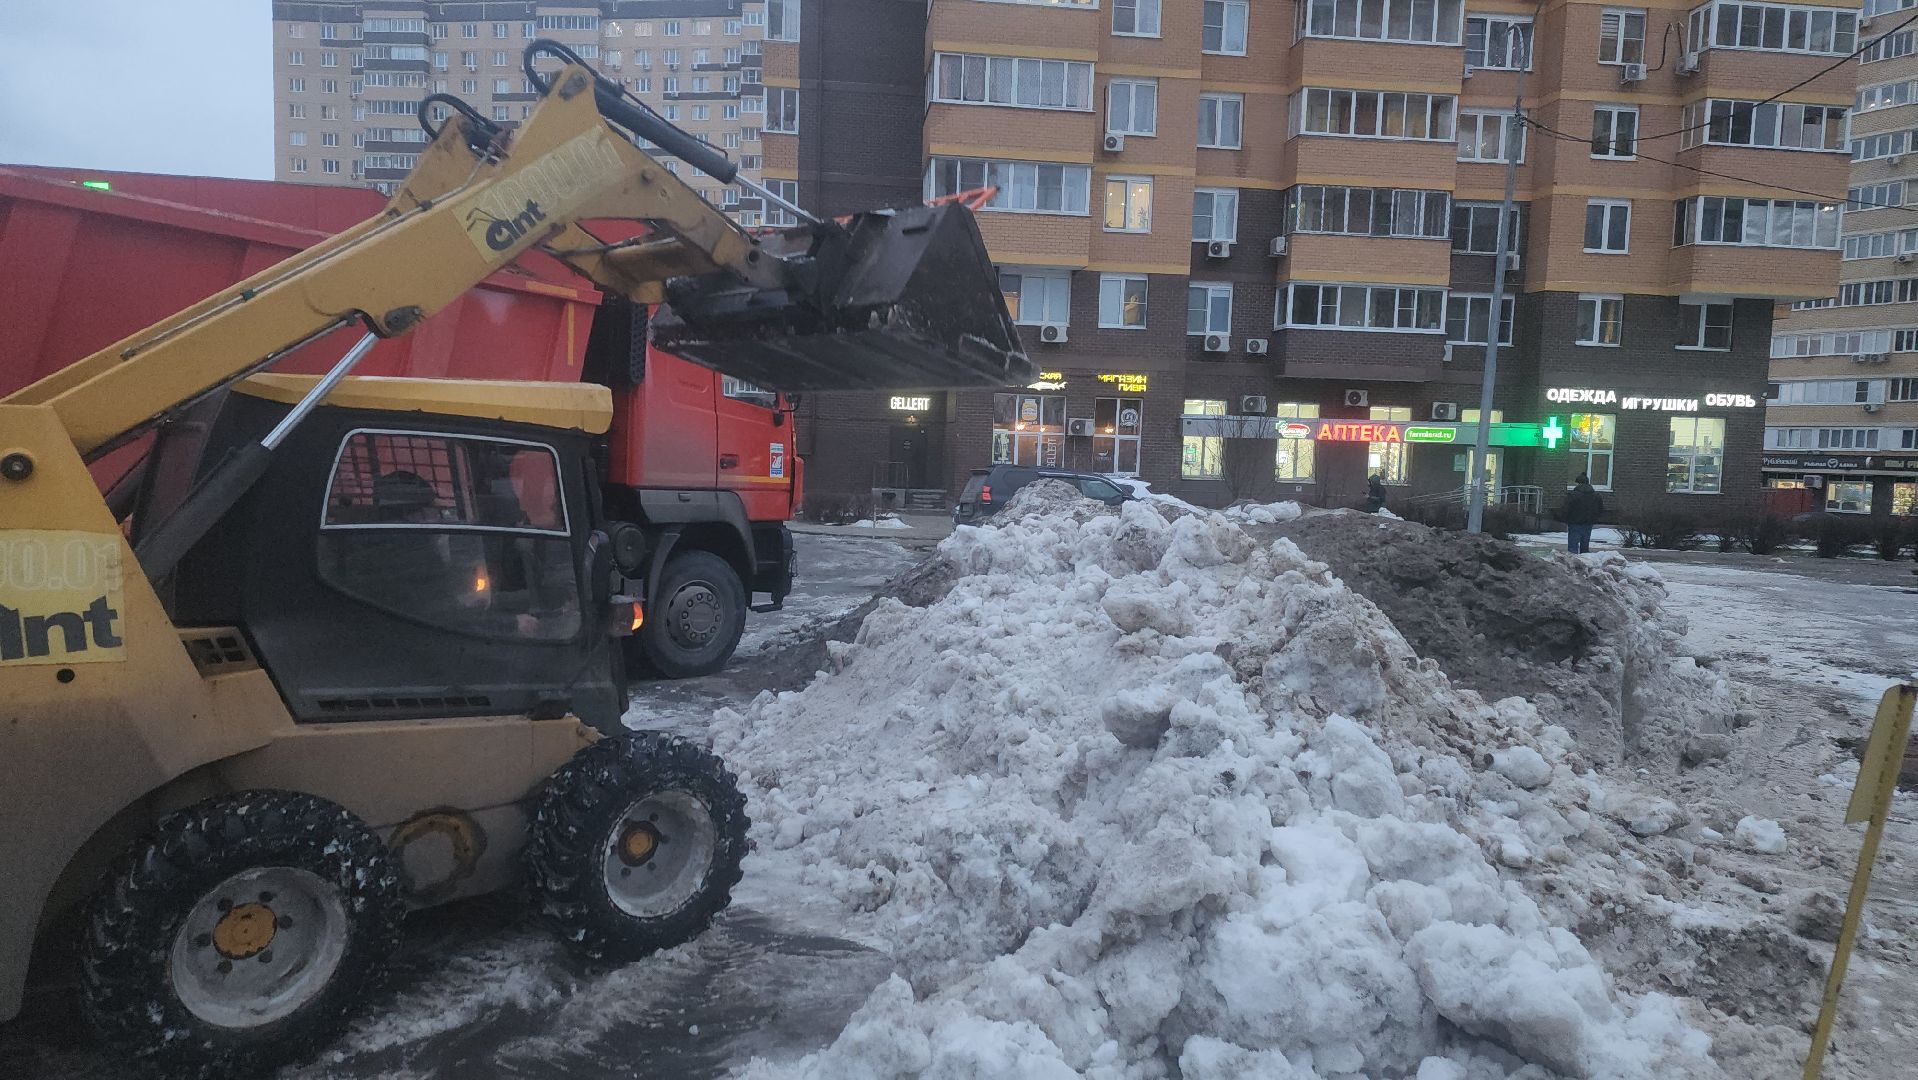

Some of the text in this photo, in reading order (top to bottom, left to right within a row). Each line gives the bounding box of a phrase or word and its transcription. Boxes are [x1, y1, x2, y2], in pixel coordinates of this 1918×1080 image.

[1097, 374, 1147, 384] МАГАЗИН
[1118, 383, 1147, 392] ПИВА
[890, 396, 931, 411] GELLERT
[1546, 388, 1756, 412] ОДЕЖДА ИГРУШКИ ОБУВЬ
[1317, 423, 1401, 442] АПТЕКА
